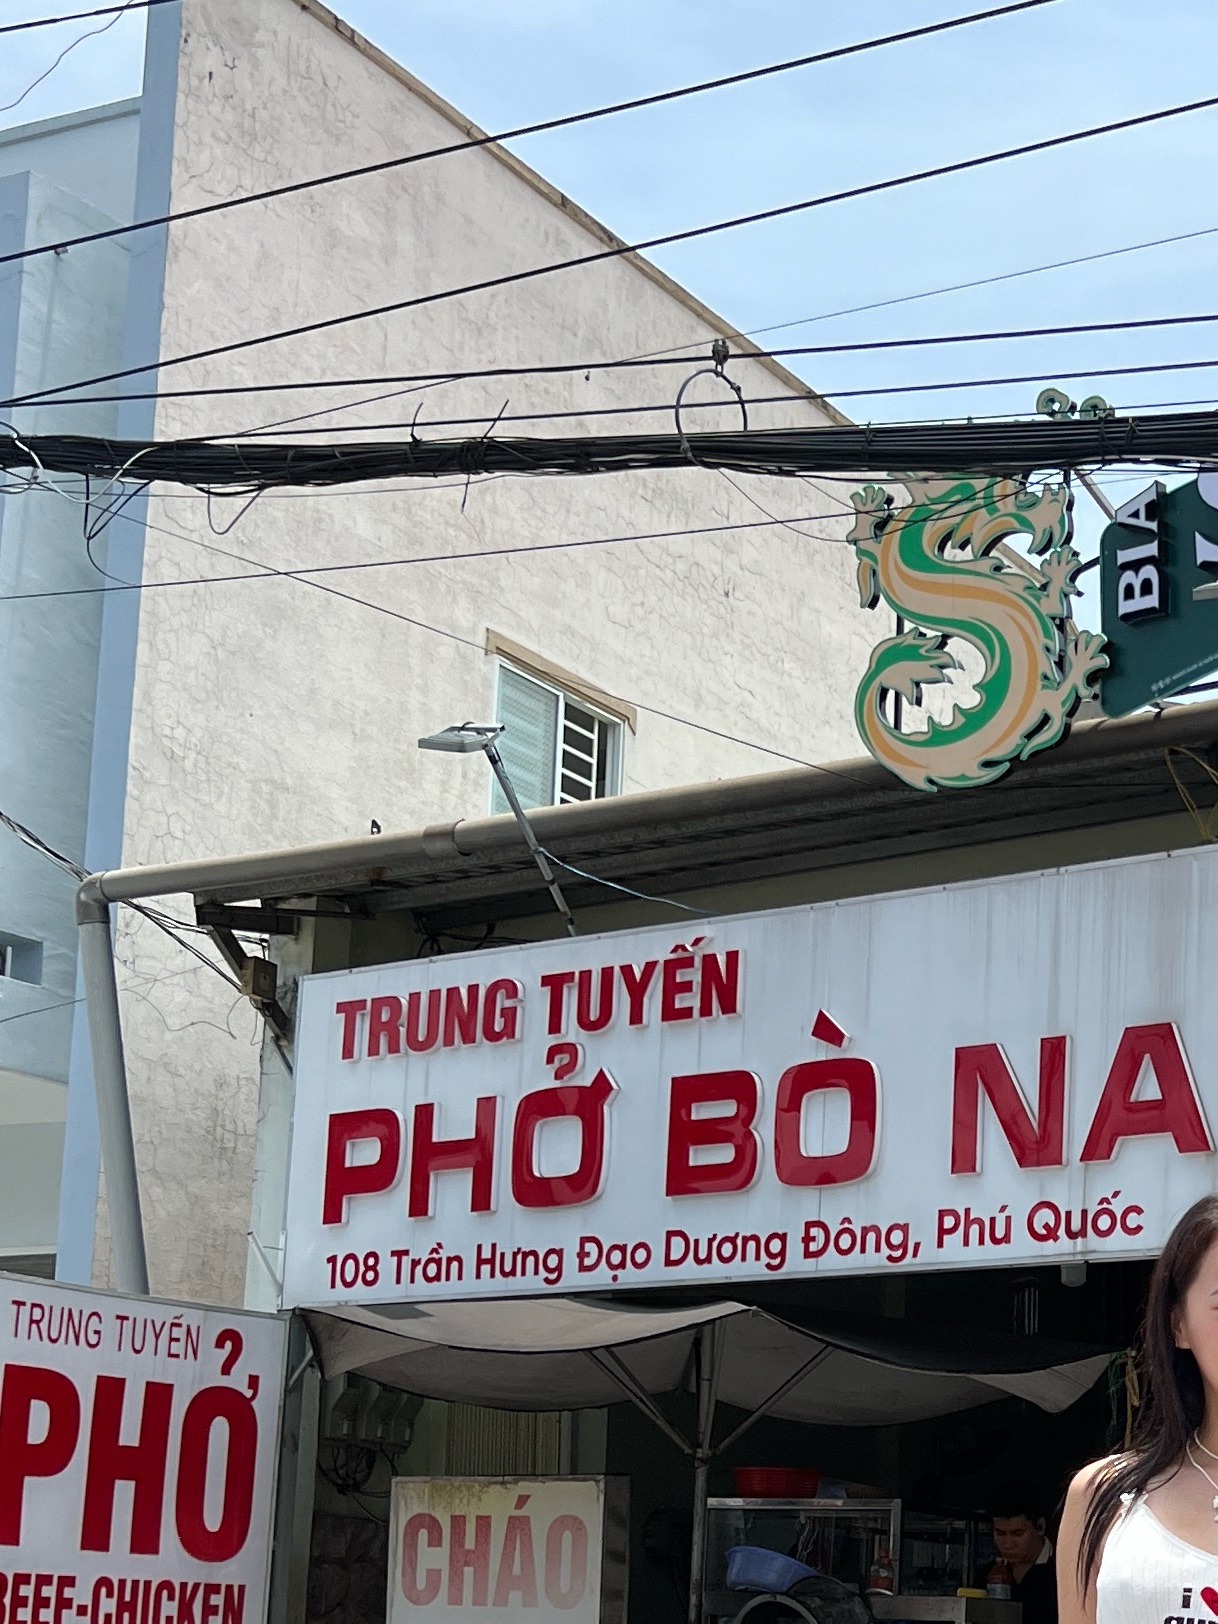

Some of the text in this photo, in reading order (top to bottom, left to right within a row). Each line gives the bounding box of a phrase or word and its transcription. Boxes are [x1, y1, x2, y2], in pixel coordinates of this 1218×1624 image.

[1115, 480, 1165, 620] BIA
[335, 936, 742, 1061] TRUNG TUYẾN
[321, 1043, 620, 1226] PHỞ
[665, 1008, 882, 1198] BÒ
[326, 1190, 1145, 1290] 108 Trần Hưng Đạo Dương Đông, Phú Quốc
[11, 1299, 201, 1361] TRUNG TUYẾN
[0, 1328, 261, 1564] PHỞ
[401, 1494, 589, 1609] CHÁO
[1180, 1587, 1193, 1609] i
